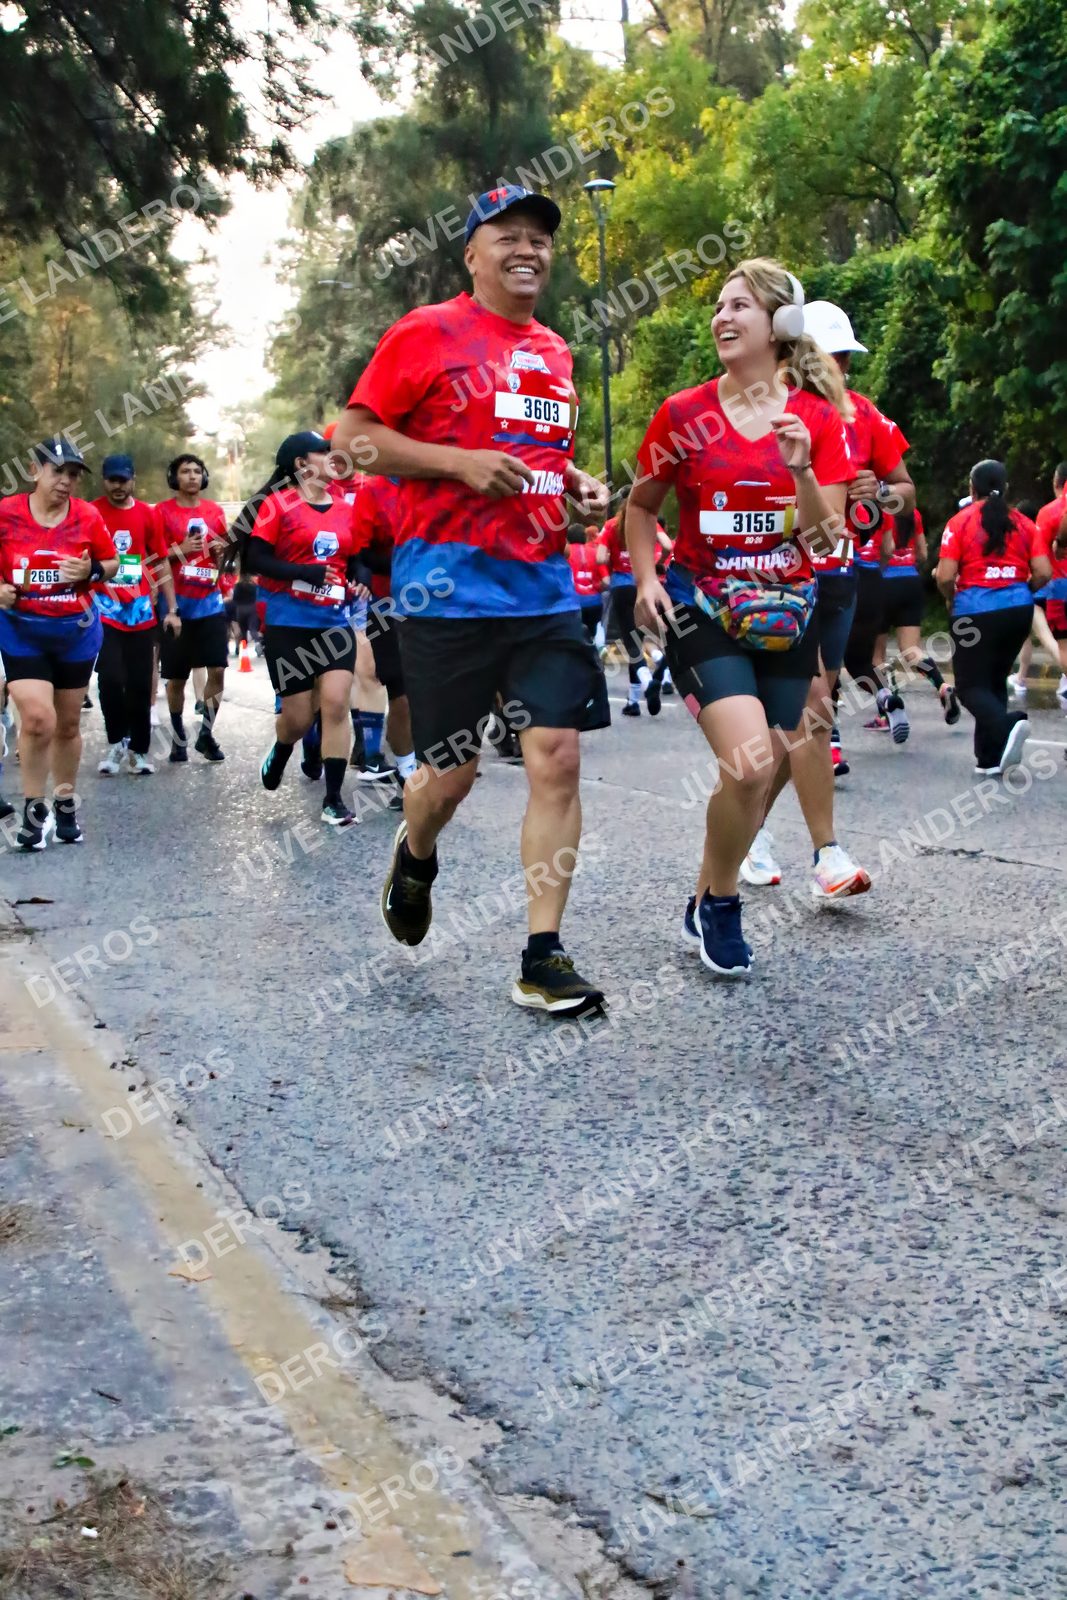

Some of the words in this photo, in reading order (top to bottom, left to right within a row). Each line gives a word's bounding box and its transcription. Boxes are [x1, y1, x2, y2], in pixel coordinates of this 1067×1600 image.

[524, 398, 559, 423] 3603
[733, 513, 775, 533] 3155
[715, 550, 795, 571] SANTIAGO
[31, 570, 60, 583] 2665
